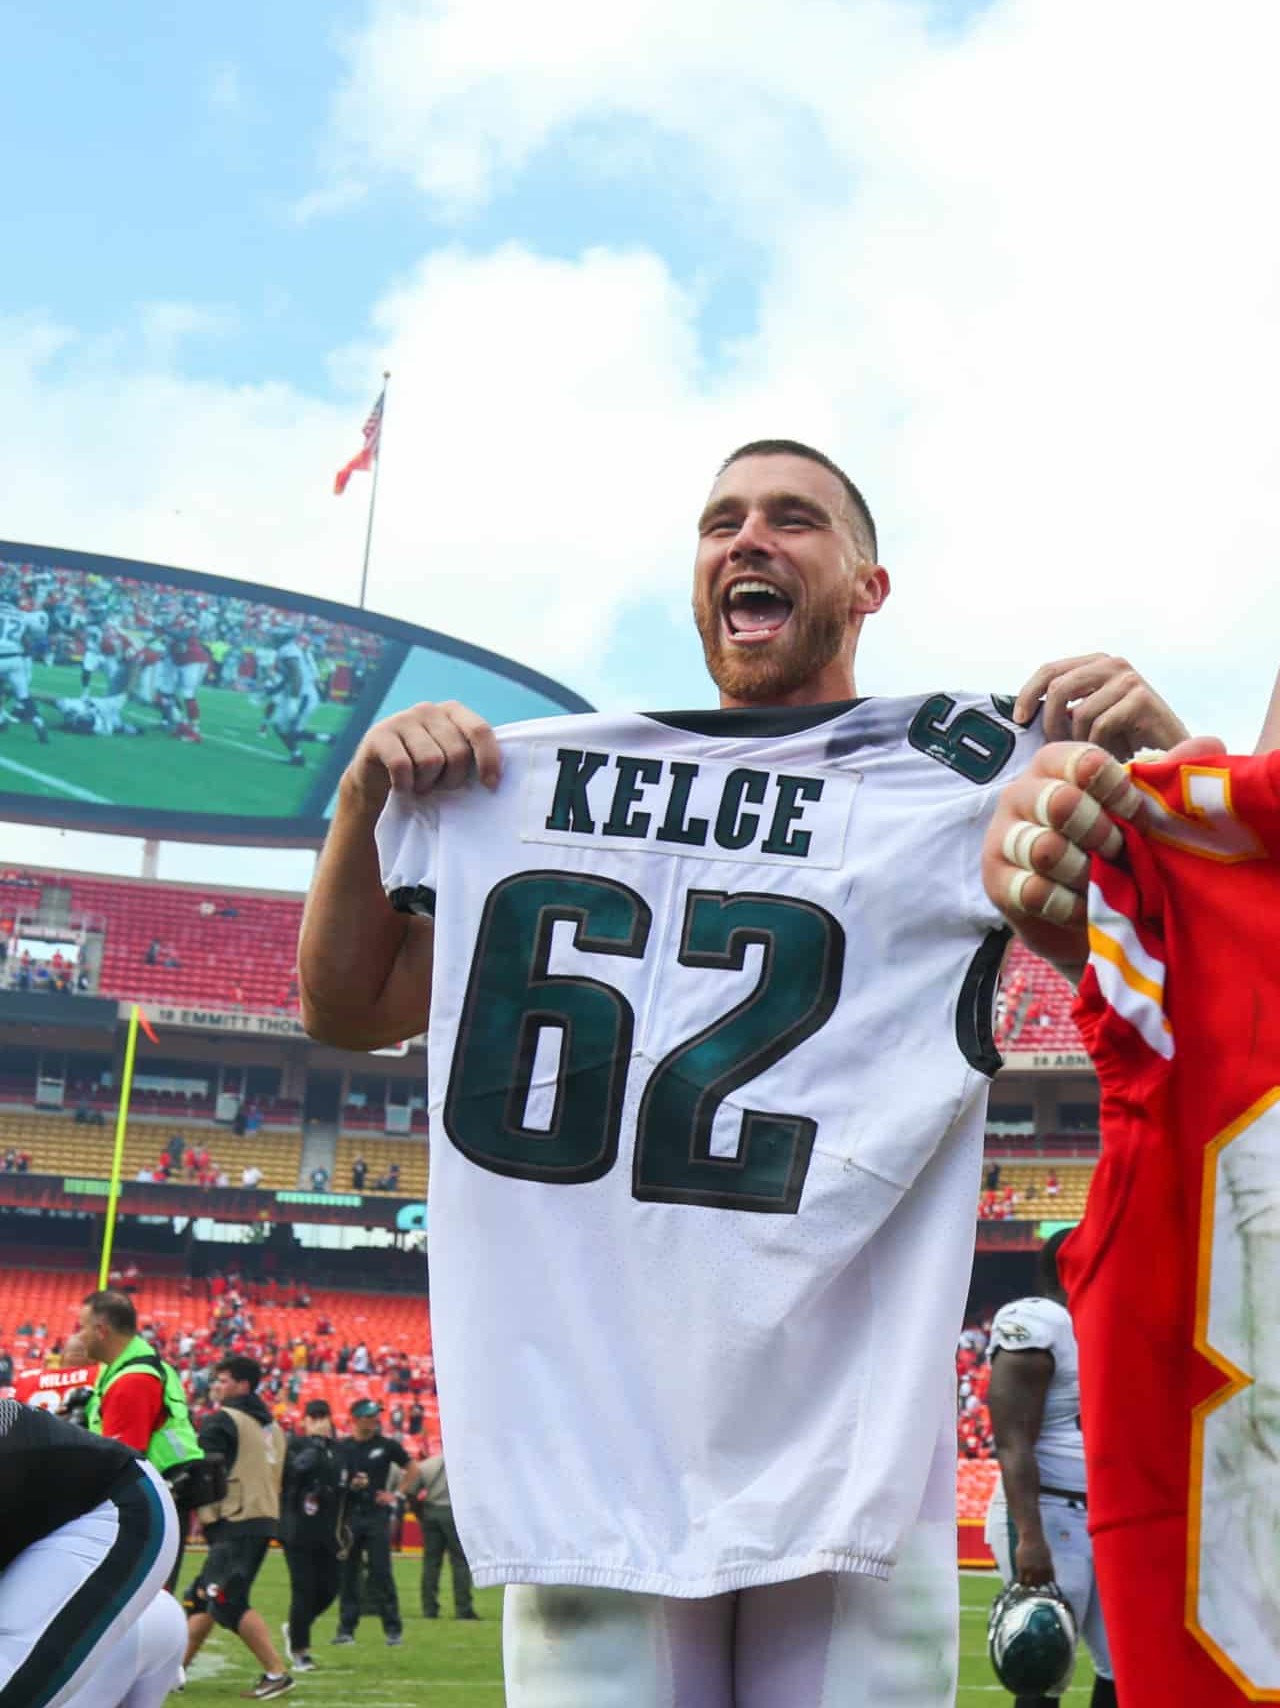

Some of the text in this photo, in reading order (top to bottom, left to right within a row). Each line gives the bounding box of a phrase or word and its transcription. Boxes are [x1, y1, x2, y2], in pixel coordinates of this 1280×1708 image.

[545, 748, 825, 858] KELCE
[181, 1010, 251, 1029] EMMITT
[442, 869, 847, 1215] 62
[39, 1368, 89, 1389] MILLER
